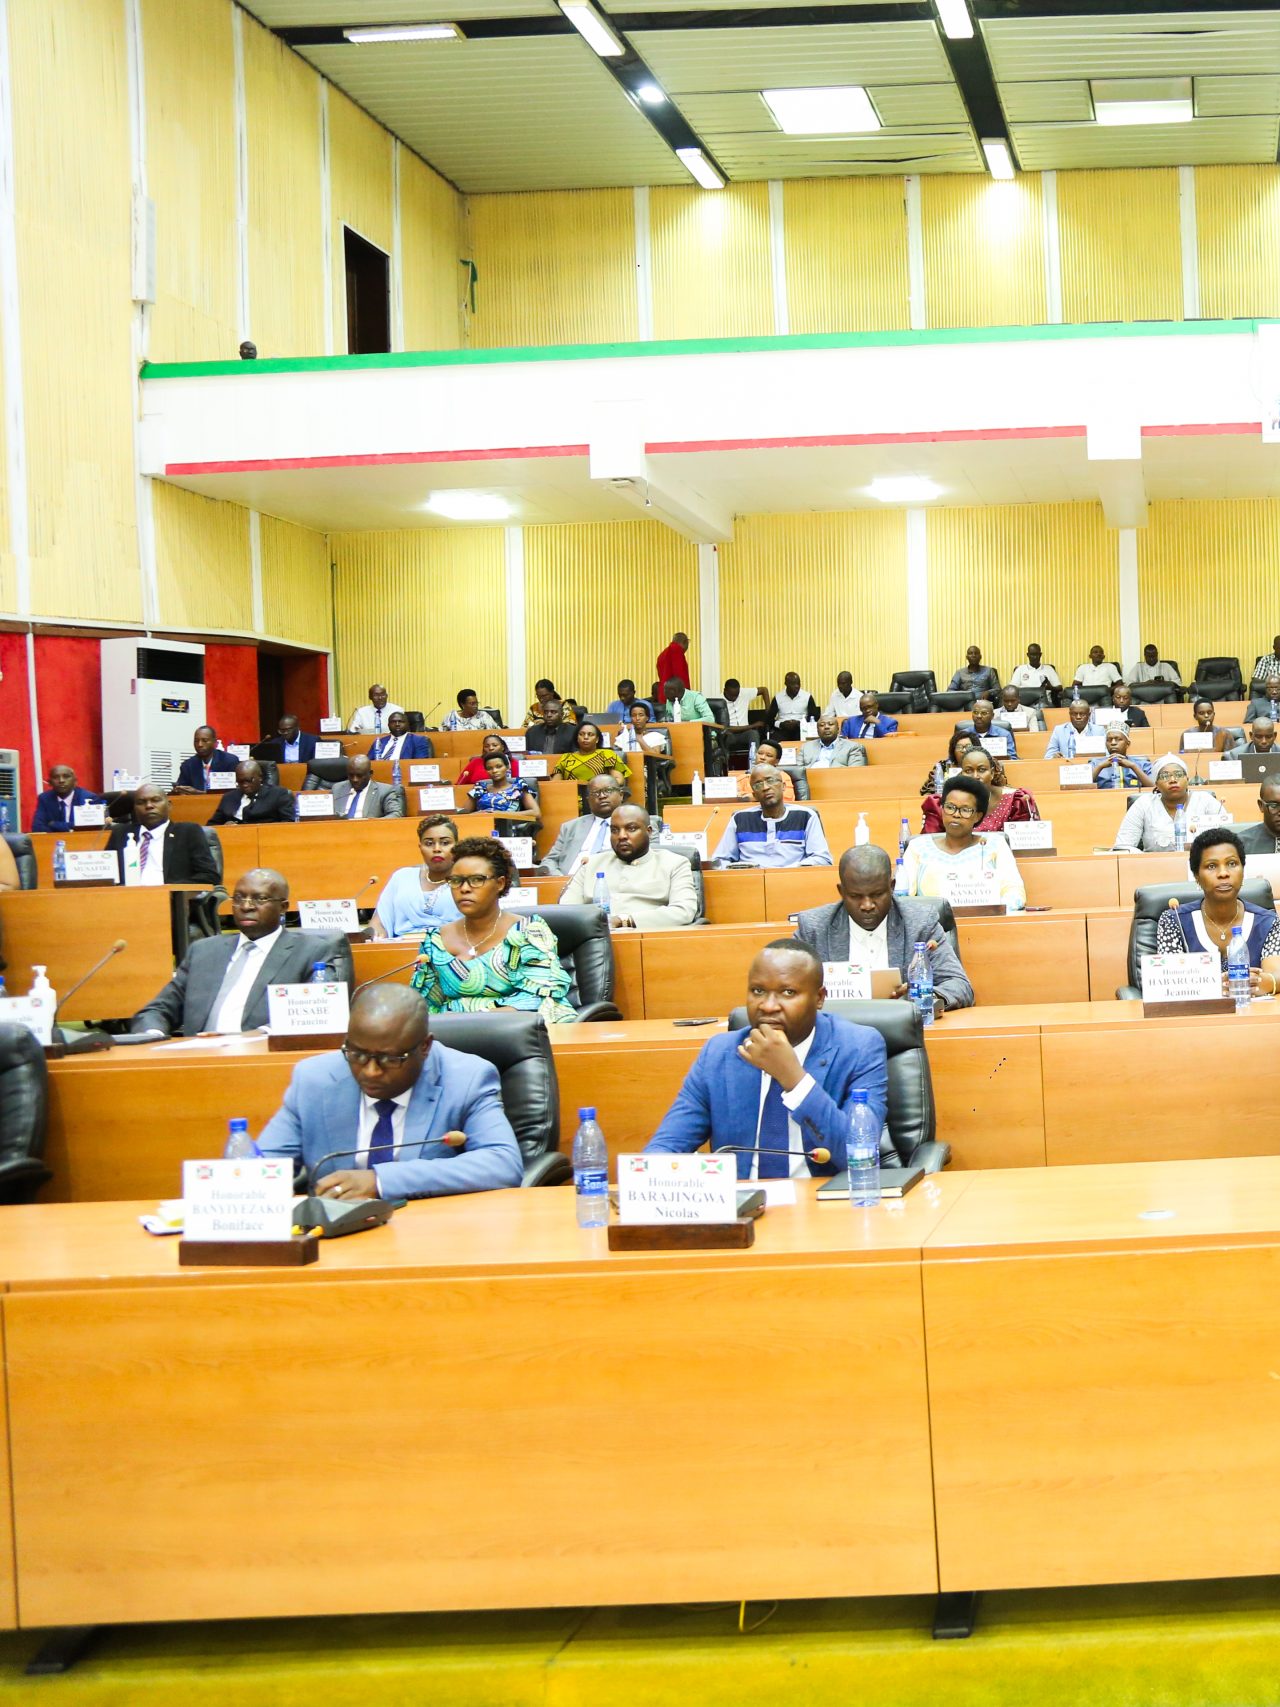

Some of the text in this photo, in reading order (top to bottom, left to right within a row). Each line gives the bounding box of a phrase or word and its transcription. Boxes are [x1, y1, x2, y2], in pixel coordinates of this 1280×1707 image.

[1162, 967, 1201, 976] Honorable
[1148, 976, 1217, 987] HABARUGIRA
[1164, 988, 1202, 997] Jeanine
[287, 997, 329, 1007] Honorable
[287, 1006, 330, 1017] DUSABE
[291, 1017, 329, 1027] Francine
[648, 1176, 706, 1188] Honorable
[212, 1189, 266, 1200] Honorable
[628, 1190, 726, 1204] BARAJINGWA
[192, 1203, 286, 1216] BANYIYEZAKO
[655, 1206, 700, 1219] Nicolas
[212, 1219, 265, 1231] Boniface
